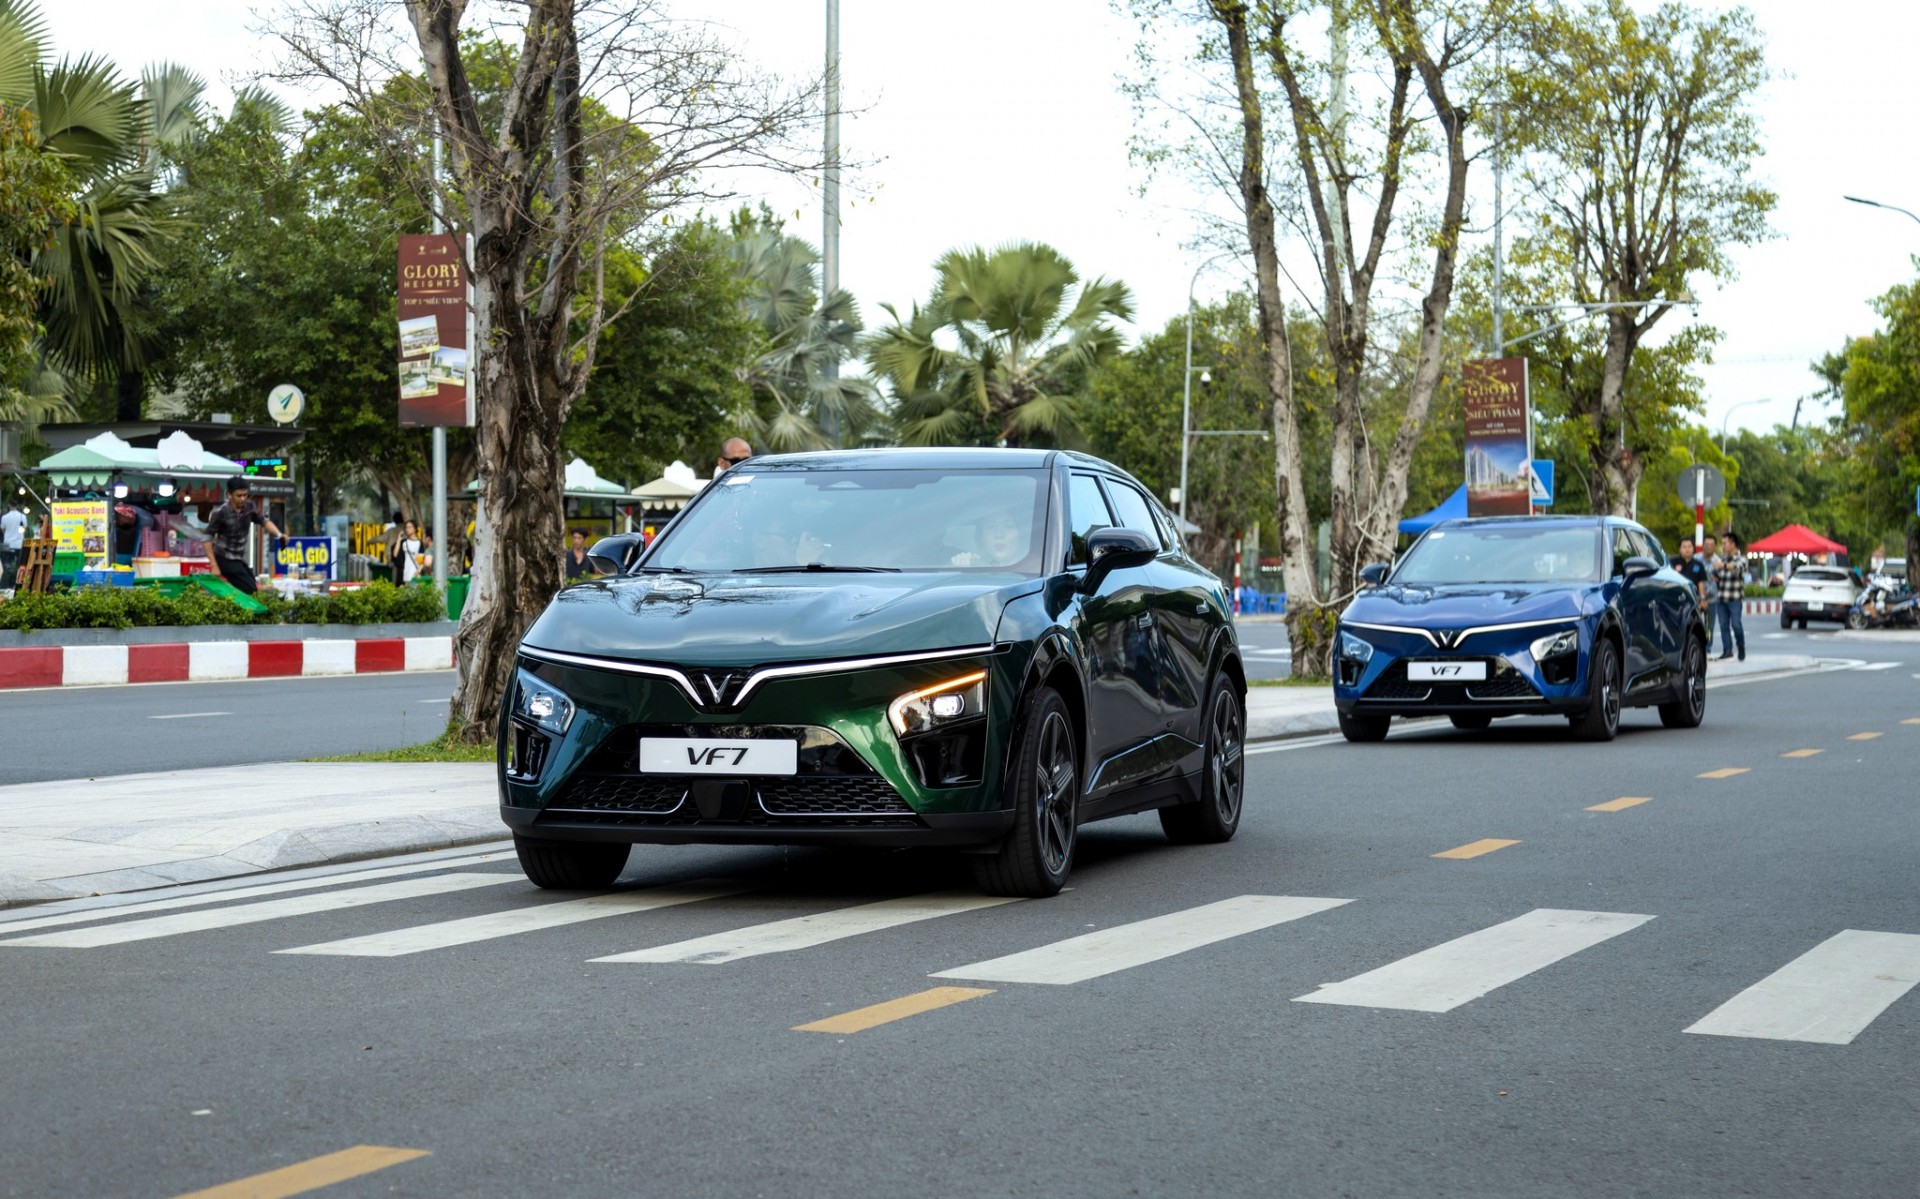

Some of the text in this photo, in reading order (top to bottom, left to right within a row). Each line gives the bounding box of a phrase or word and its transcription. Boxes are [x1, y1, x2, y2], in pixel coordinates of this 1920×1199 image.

[404, 264, 460, 278] GLORY
[404, 279, 460, 288] HEIGHTS
[278, 541, 304, 565] CHẢ
[305, 543, 329, 564] GIÒ
[1431, 666, 1462, 675] VF7
[687, 747, 749, 766] VF7
